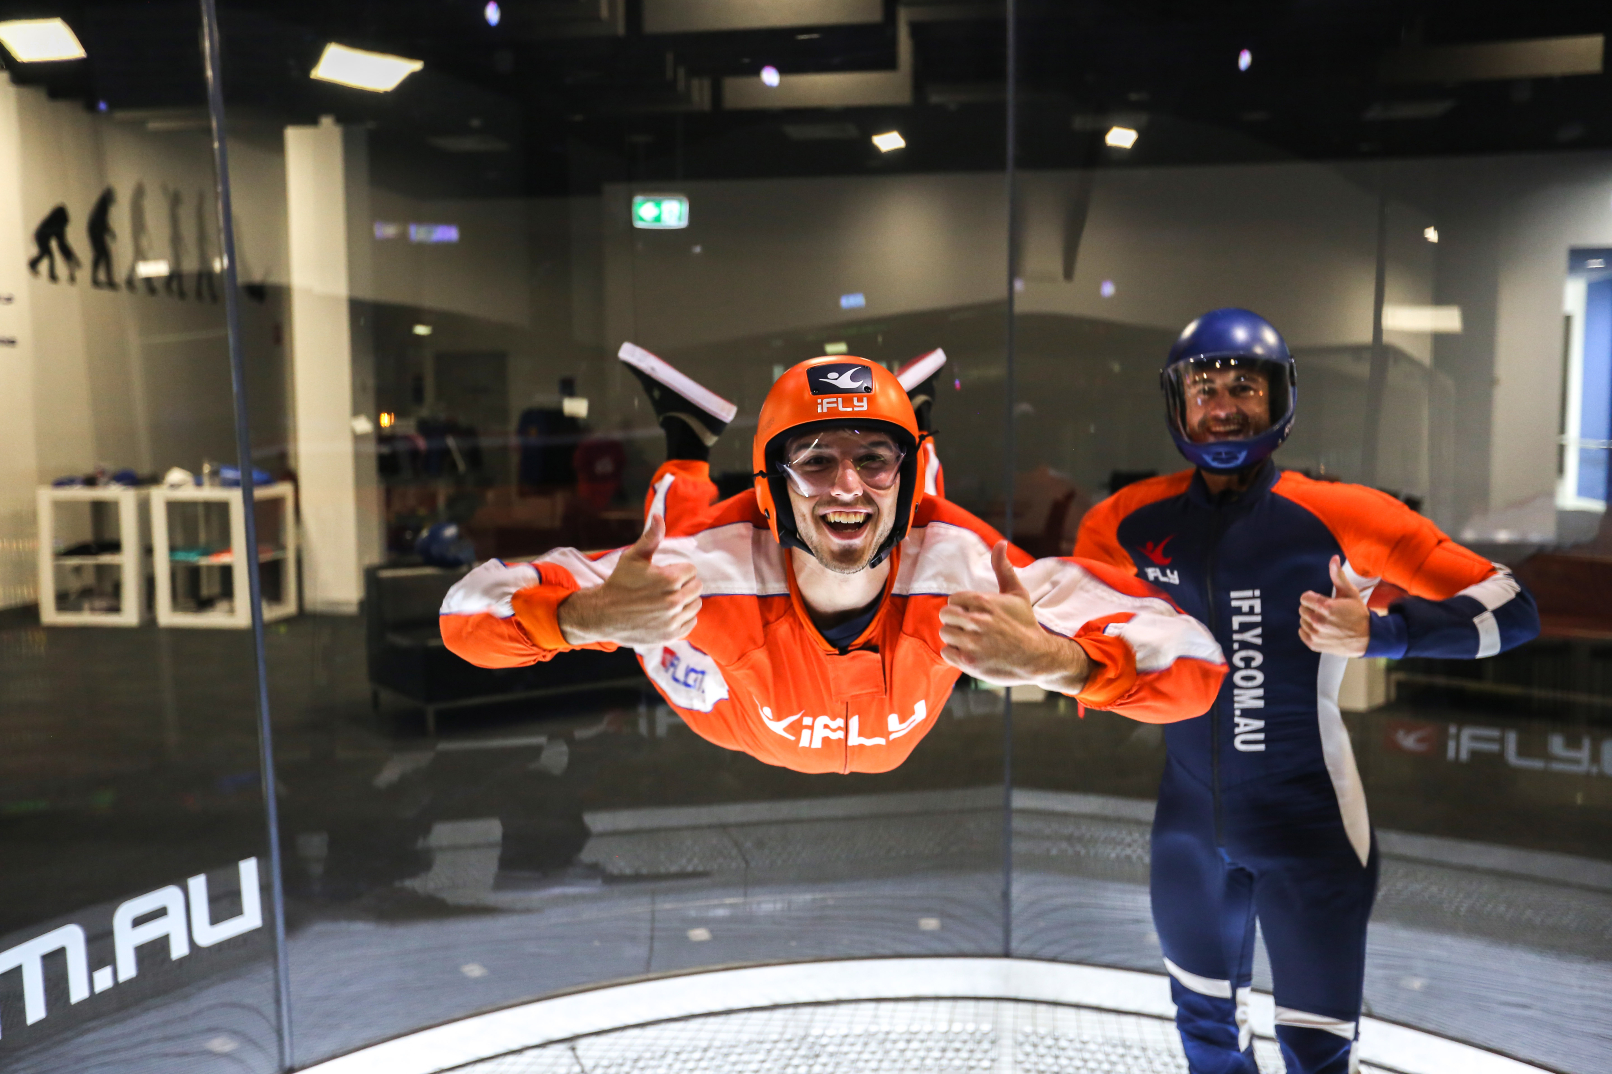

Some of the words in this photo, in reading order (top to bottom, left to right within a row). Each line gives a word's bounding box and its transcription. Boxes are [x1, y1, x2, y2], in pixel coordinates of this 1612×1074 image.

[817, 397, 868, 413] iFLY
[1230, 589, 1266, 752] iFLY.COM.AU
[799, 700, 927, 749] iFLY
[1446, 723, 1612, 777] iFLY.
